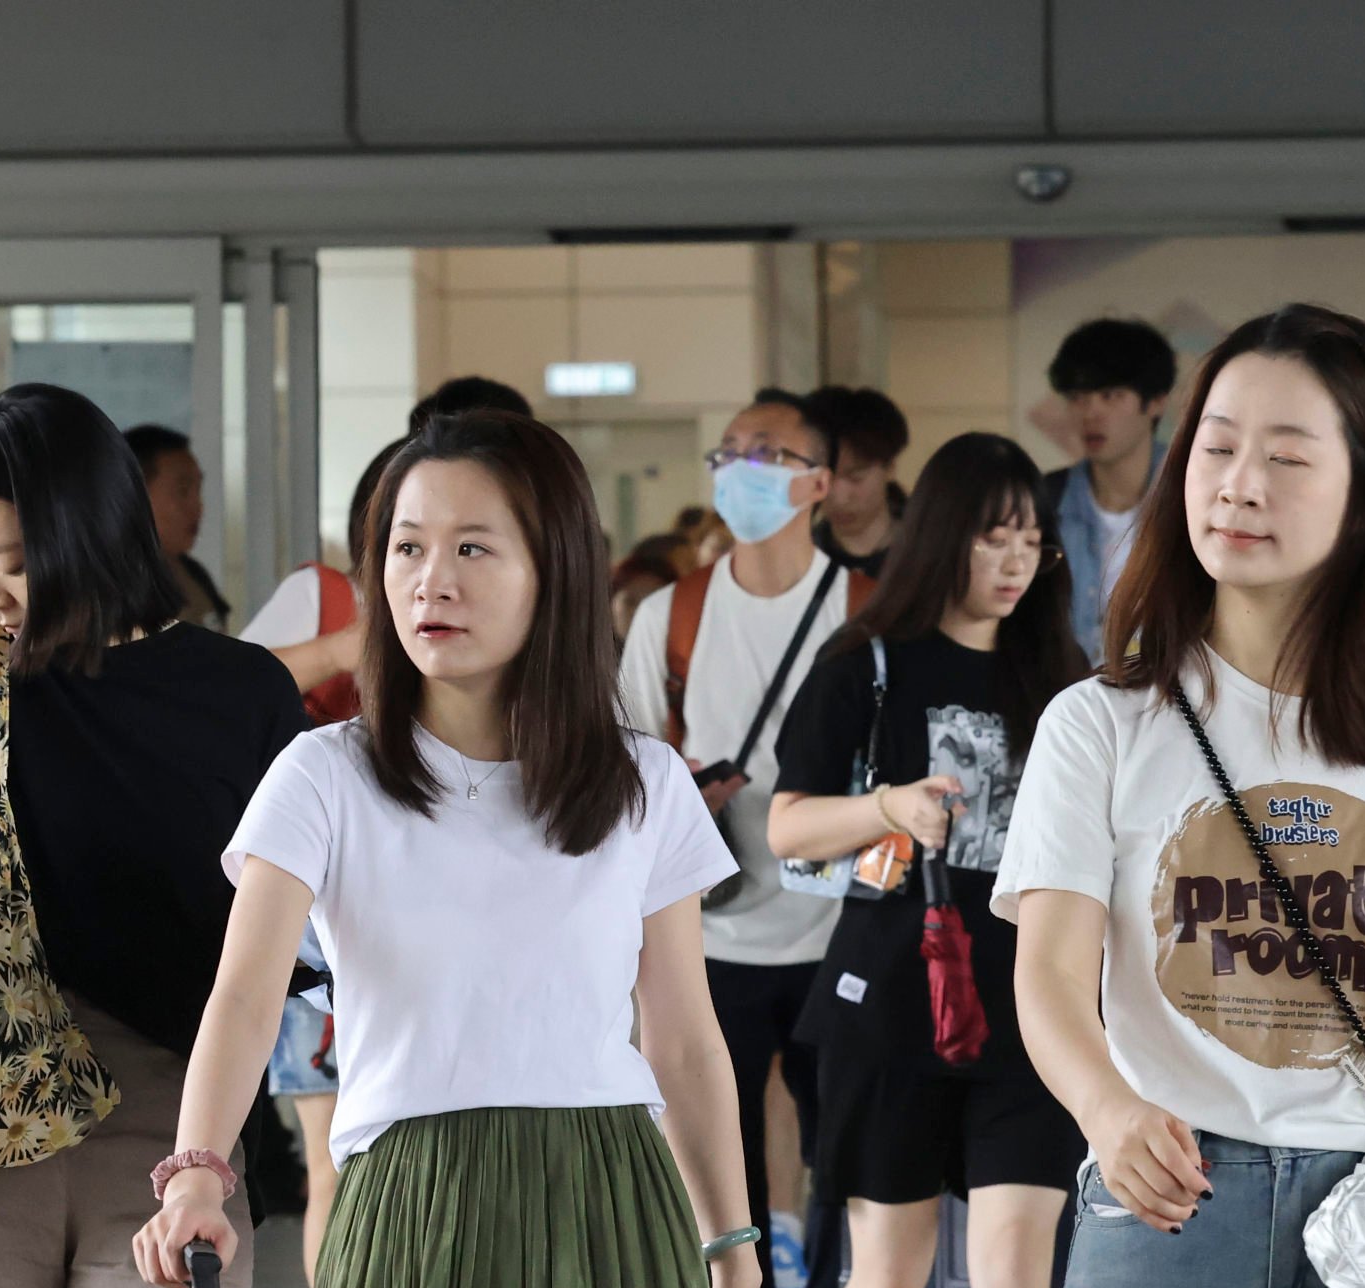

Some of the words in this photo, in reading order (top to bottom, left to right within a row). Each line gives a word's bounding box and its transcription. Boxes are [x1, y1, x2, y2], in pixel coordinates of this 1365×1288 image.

[1211, 993, 1230, 1003] hold
[1275, 998, 1288, 1007] for
[1289, 999, 1304, 1008] the
[1181, 1003, 1200, 1011] what
[1201, 1004, 1216, 1013] you
[1243, 1007, 1252, 1015] to
[1297, 1010, 1318, 1018] them
[1272, 1022, 1288, 1030] and
